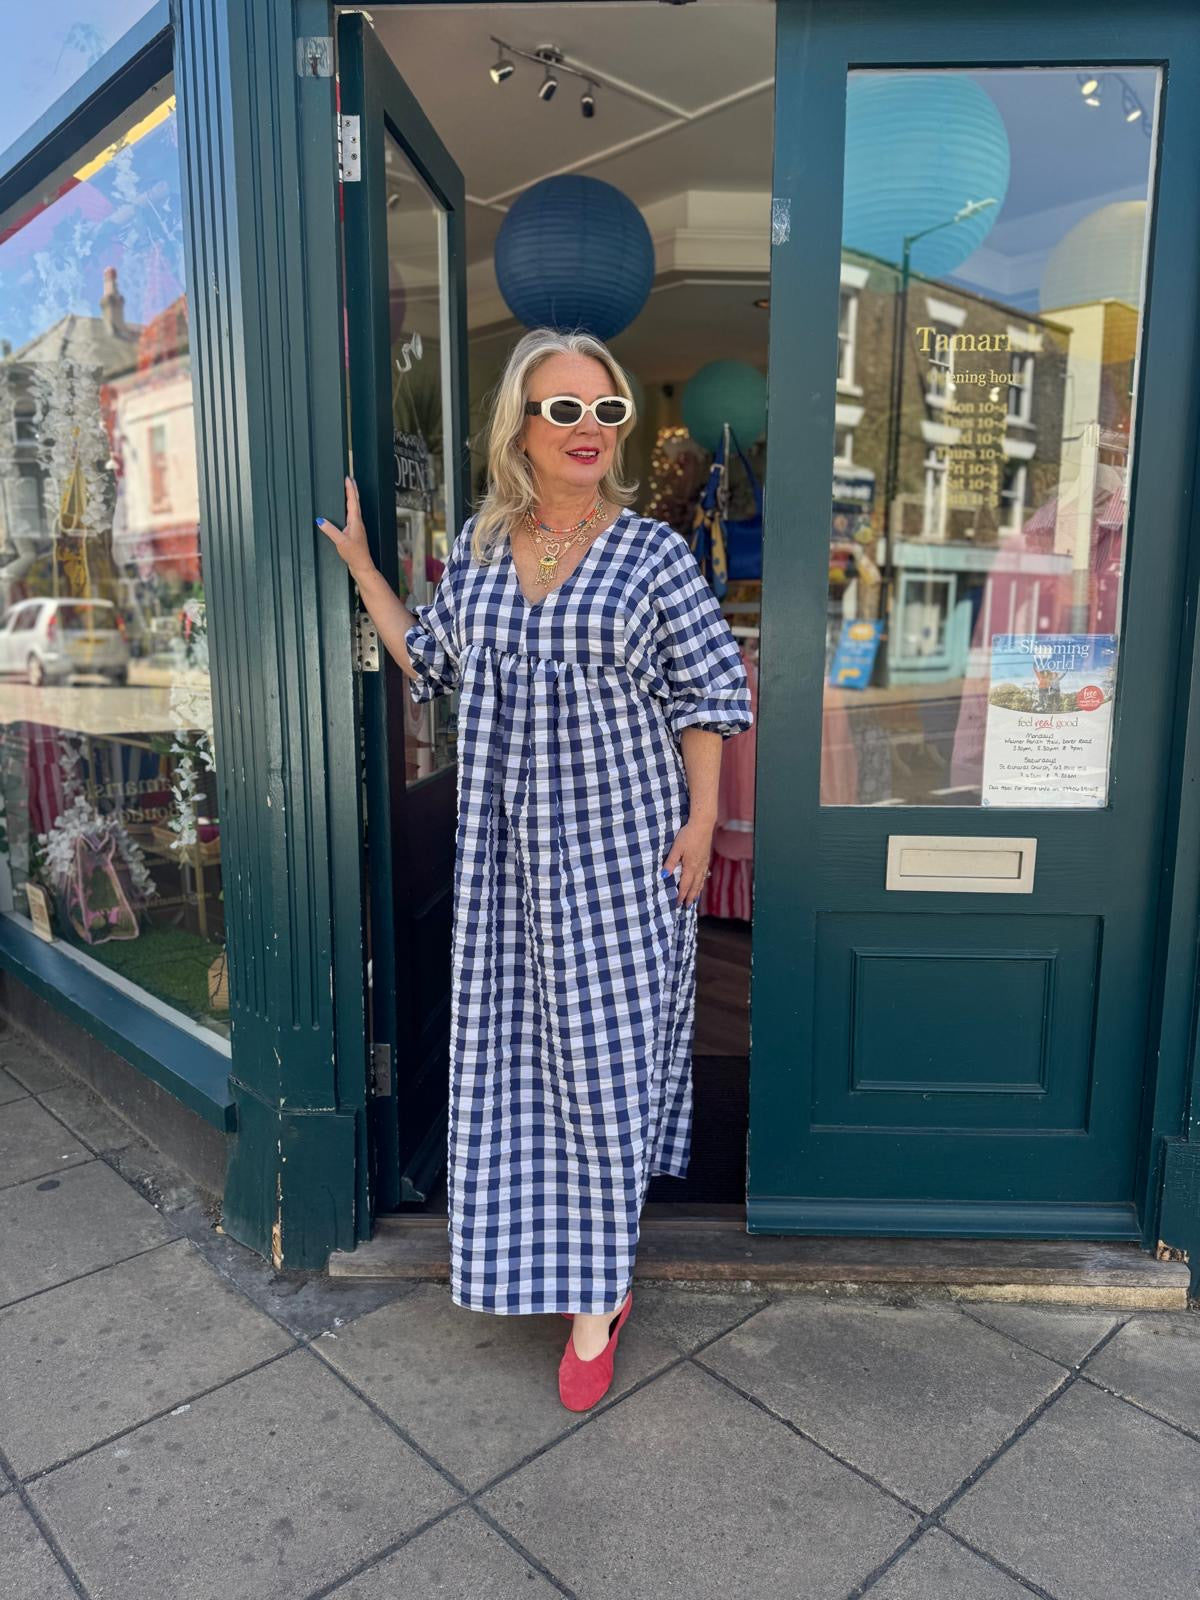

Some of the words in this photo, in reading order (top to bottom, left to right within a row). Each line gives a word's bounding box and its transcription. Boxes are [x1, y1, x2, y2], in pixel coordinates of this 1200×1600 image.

[1020, 639, 1090, 657] Slimming
[1033, 654, 1074, 670] World
[1017, 716, 1033, 727] feel
[1035, 715, 1054, 728] real
[1056, 716, 1079, 729] good
